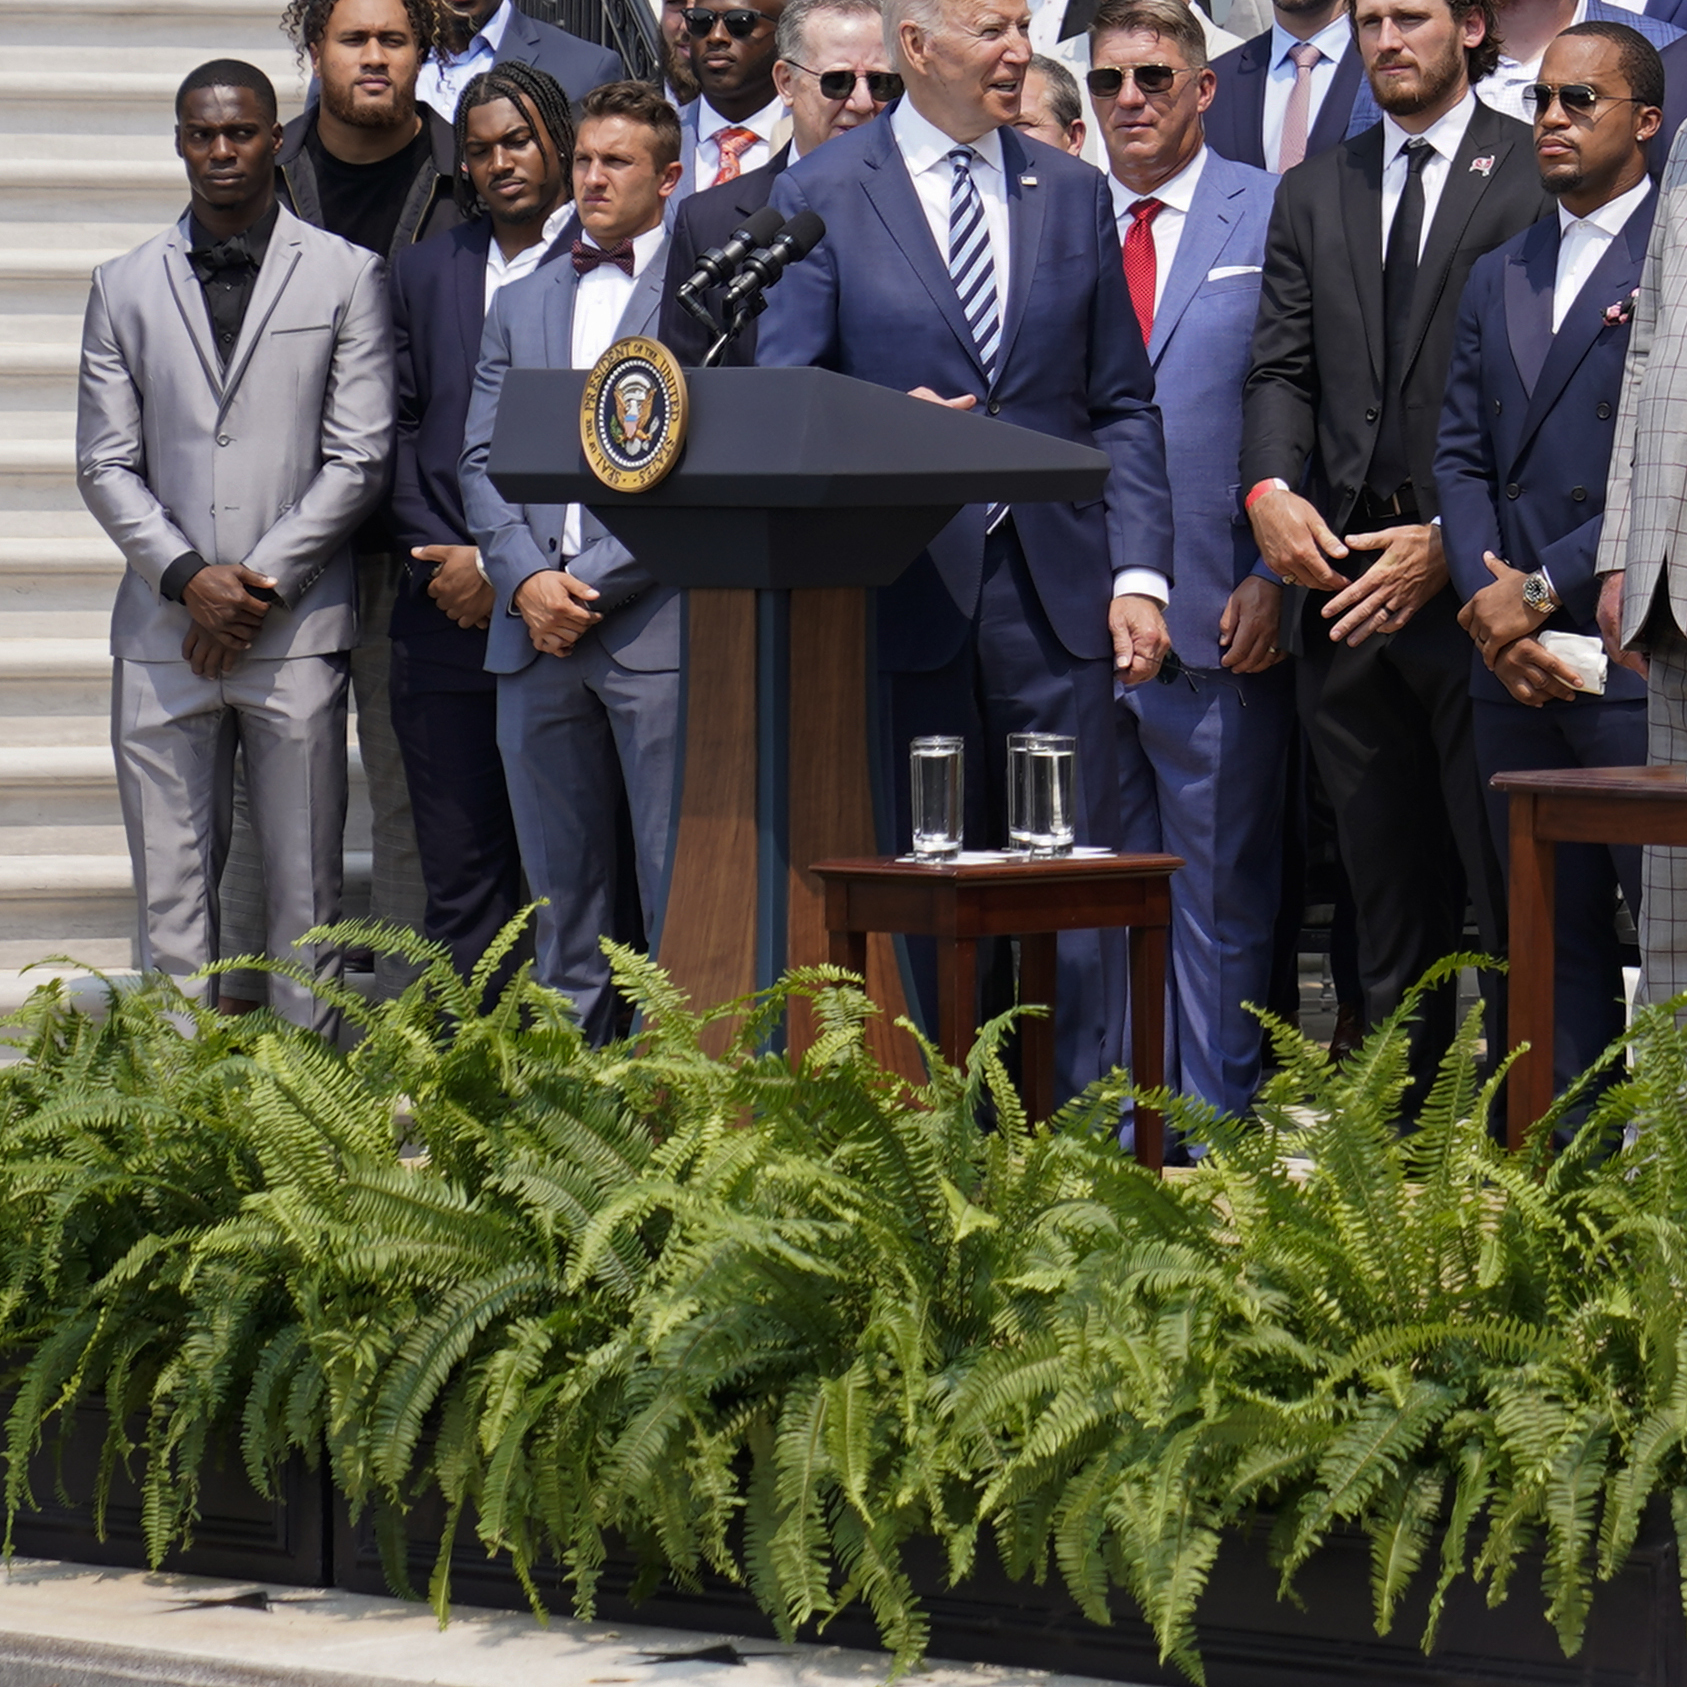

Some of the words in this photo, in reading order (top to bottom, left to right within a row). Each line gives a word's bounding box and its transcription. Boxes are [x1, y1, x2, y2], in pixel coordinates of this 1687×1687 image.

[585, 342, 631, 411] PRESIDENT
[660, 360, 680, 422] UNITED
[596, 454, 621, 484] SEAL
[639, 437, 675, 484] STATES
